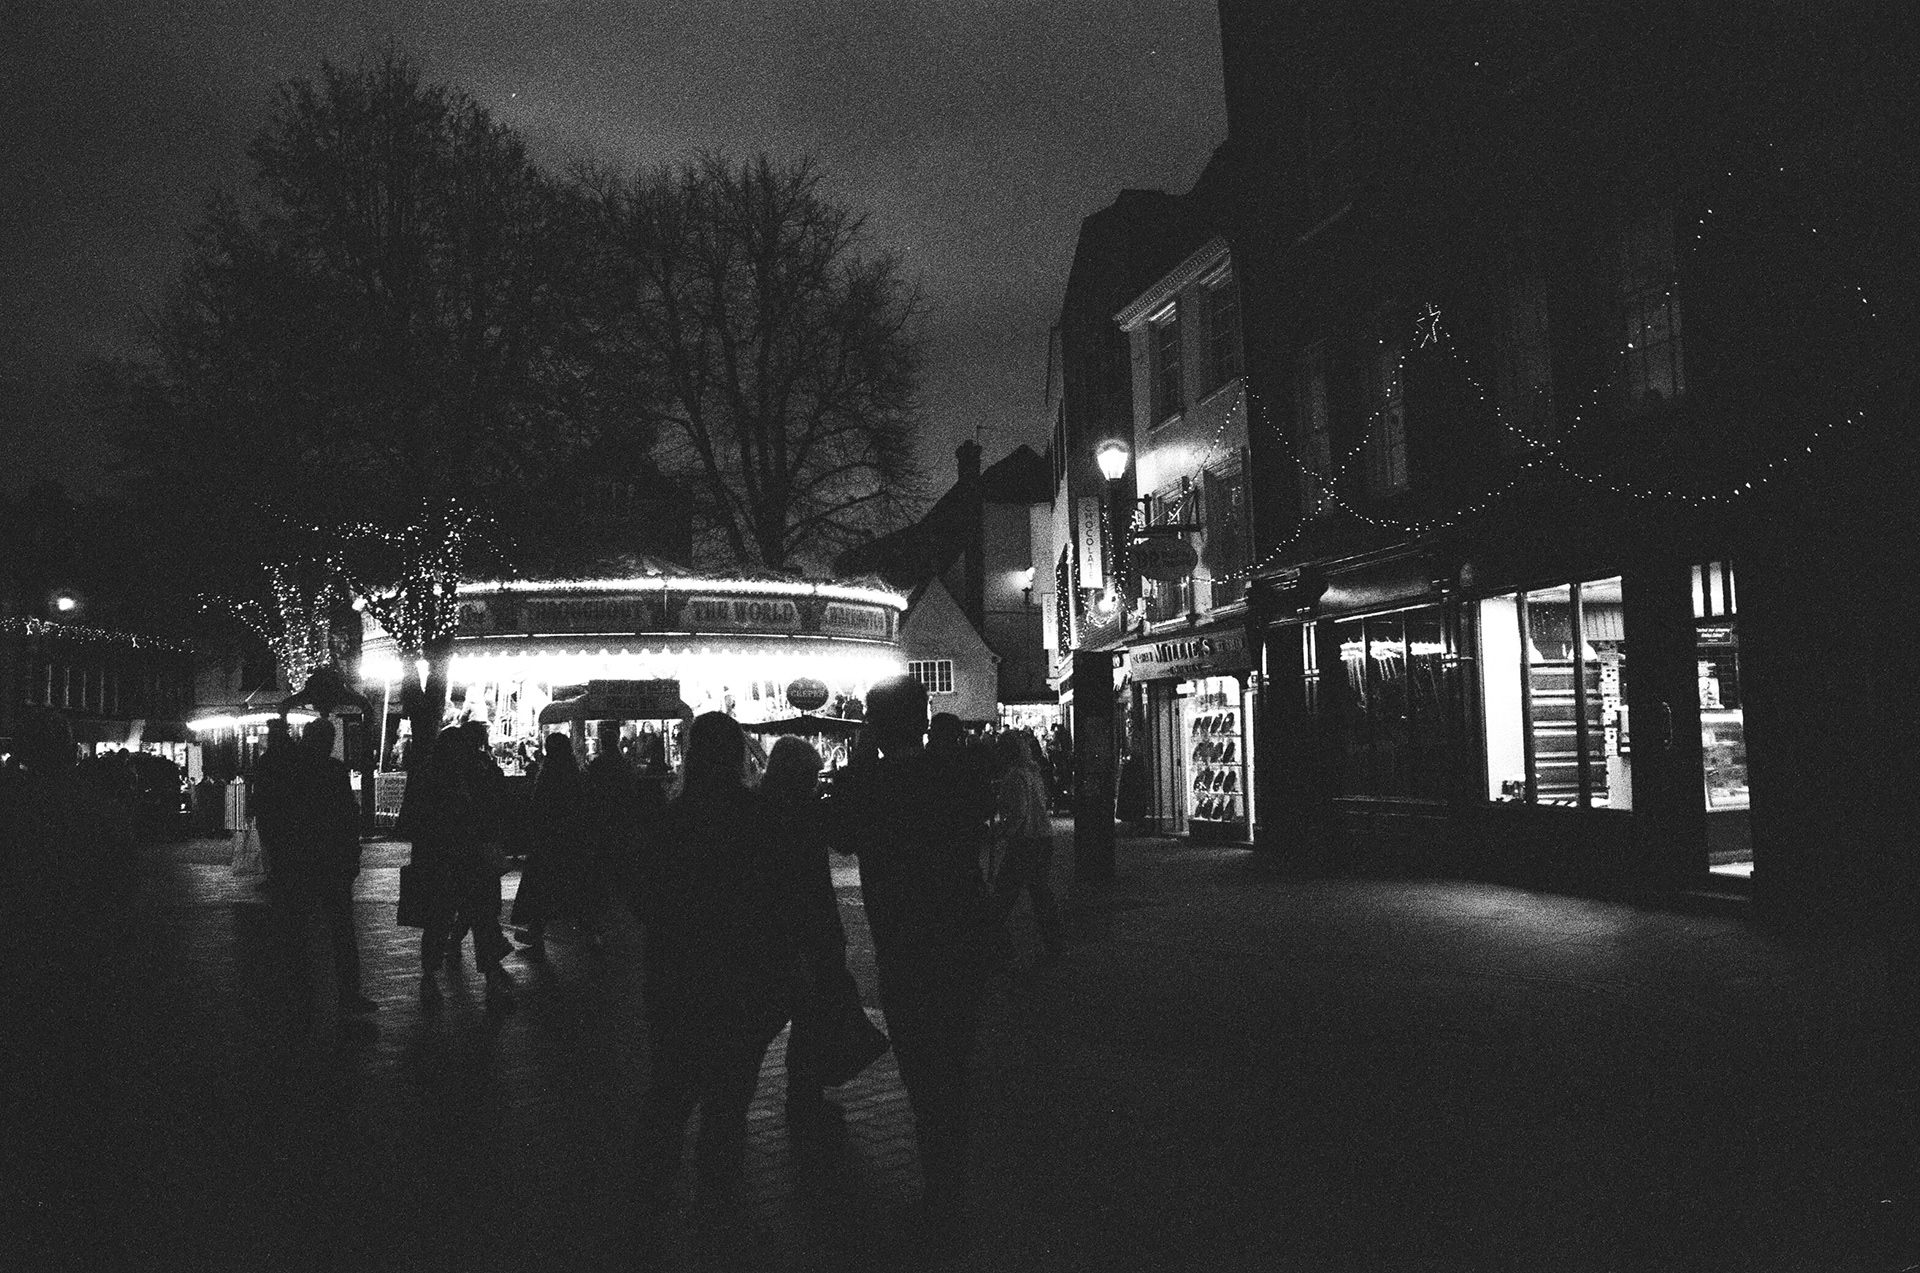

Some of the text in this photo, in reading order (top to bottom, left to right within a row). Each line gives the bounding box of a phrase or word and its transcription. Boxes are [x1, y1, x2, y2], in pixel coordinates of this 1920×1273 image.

[1085, 504, 1095, 580] CHOCOLATE
[692, 600, 728, 621] THE
[732, 601, 793, 624] WORLD
